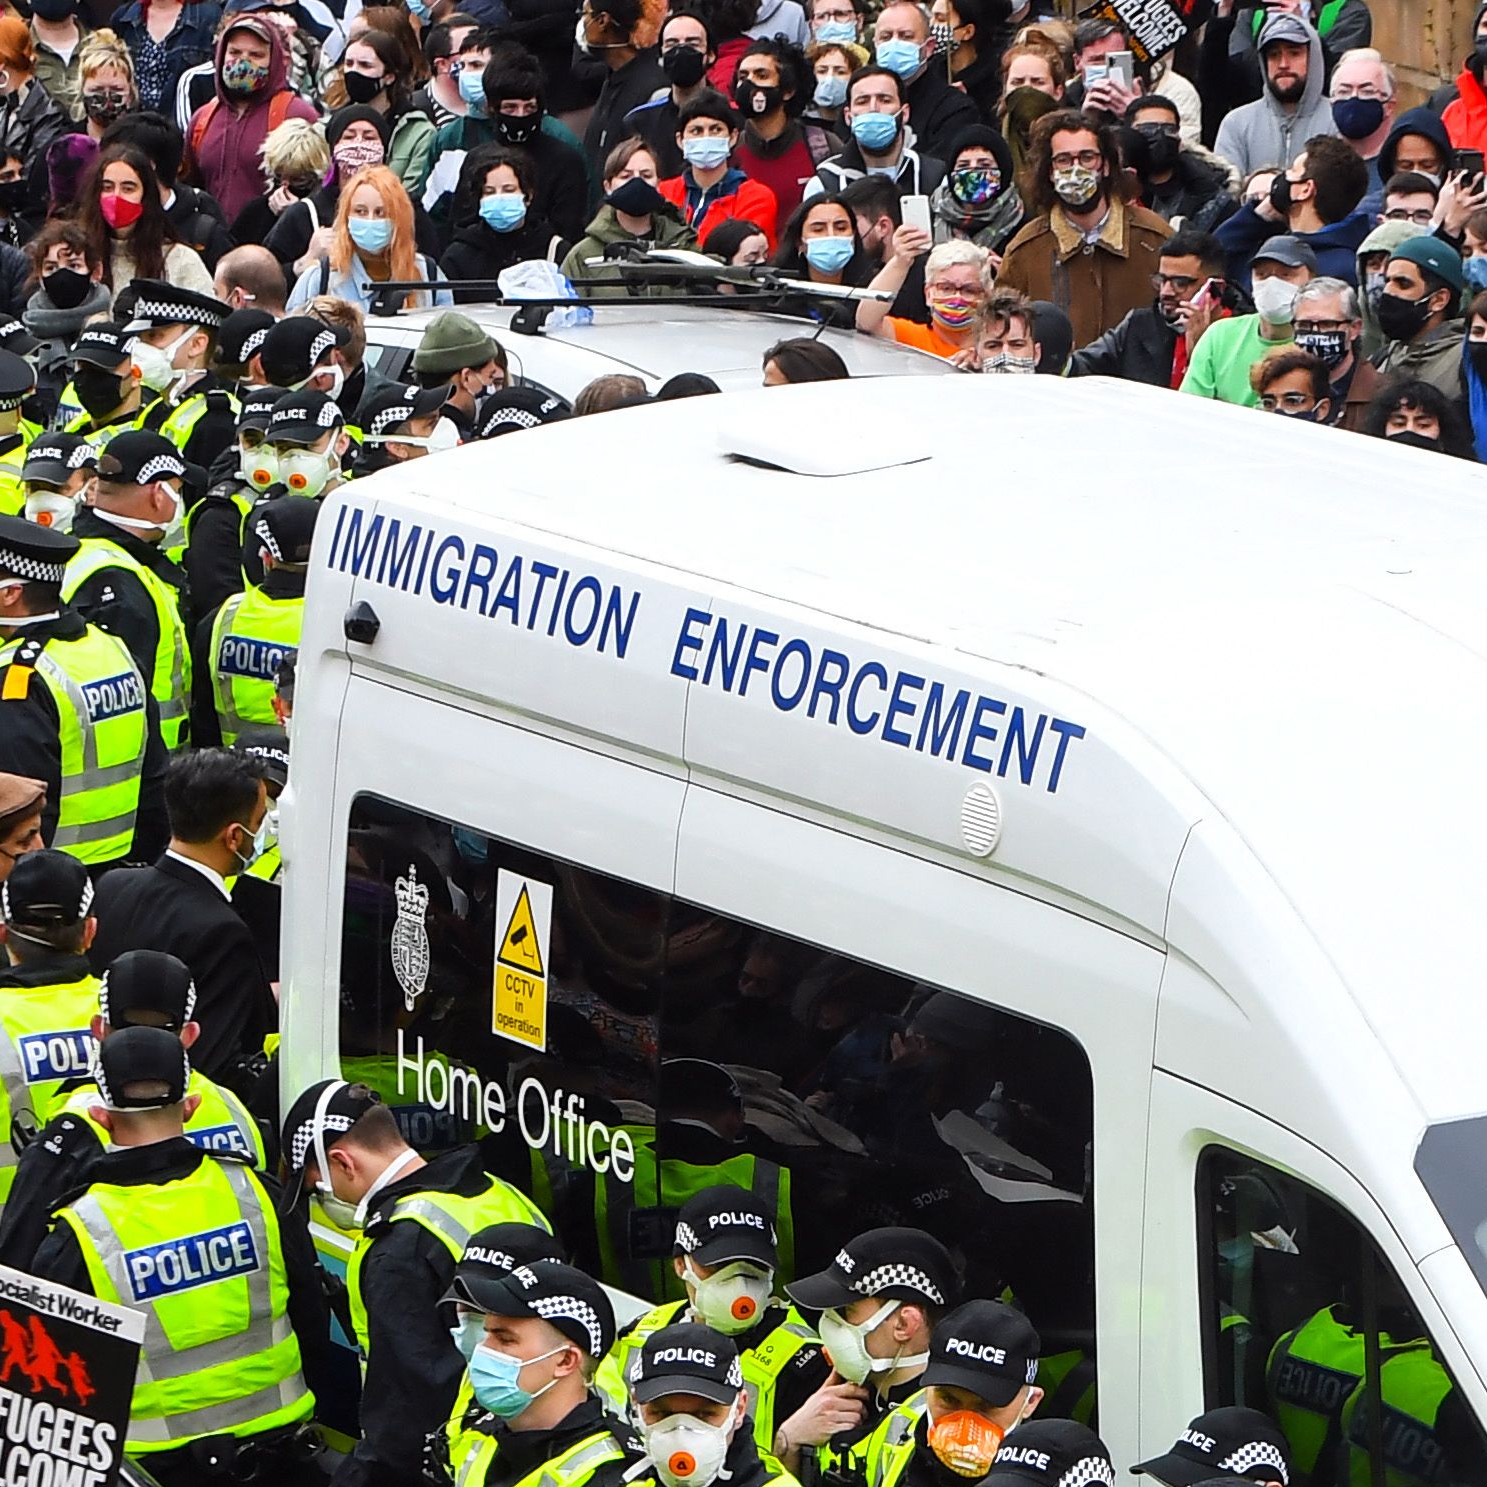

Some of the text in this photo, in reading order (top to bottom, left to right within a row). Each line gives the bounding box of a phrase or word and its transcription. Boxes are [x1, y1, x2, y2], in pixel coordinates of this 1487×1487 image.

[1113, 0, 1175, 57] ELCOME
[81, 333, 118, 347] POLICE
[328, 504, 1086, 795] IMMIGRATION ENFORCEMENT
[87, 677, 142, 719] POLICE
[505, 974, 536, 999] CCTV
[514, 998, 524, 1013] in
[497, 1012, 541, 1040] operation
[397, 1028, 635, 1184] Home Office
[709, 1211, 765, 1232] POLICE
[126, 1229, 255, 1294] POLICE
[464, 1246, 515, 1272] POLICE
[56, 1290, 124, 1333] Worker
[652, 1346, 716, 1369] POLICE
[946, 1337, 1007, 1365] POLICE
[995, 1445, 1051, 1471] POLICE
